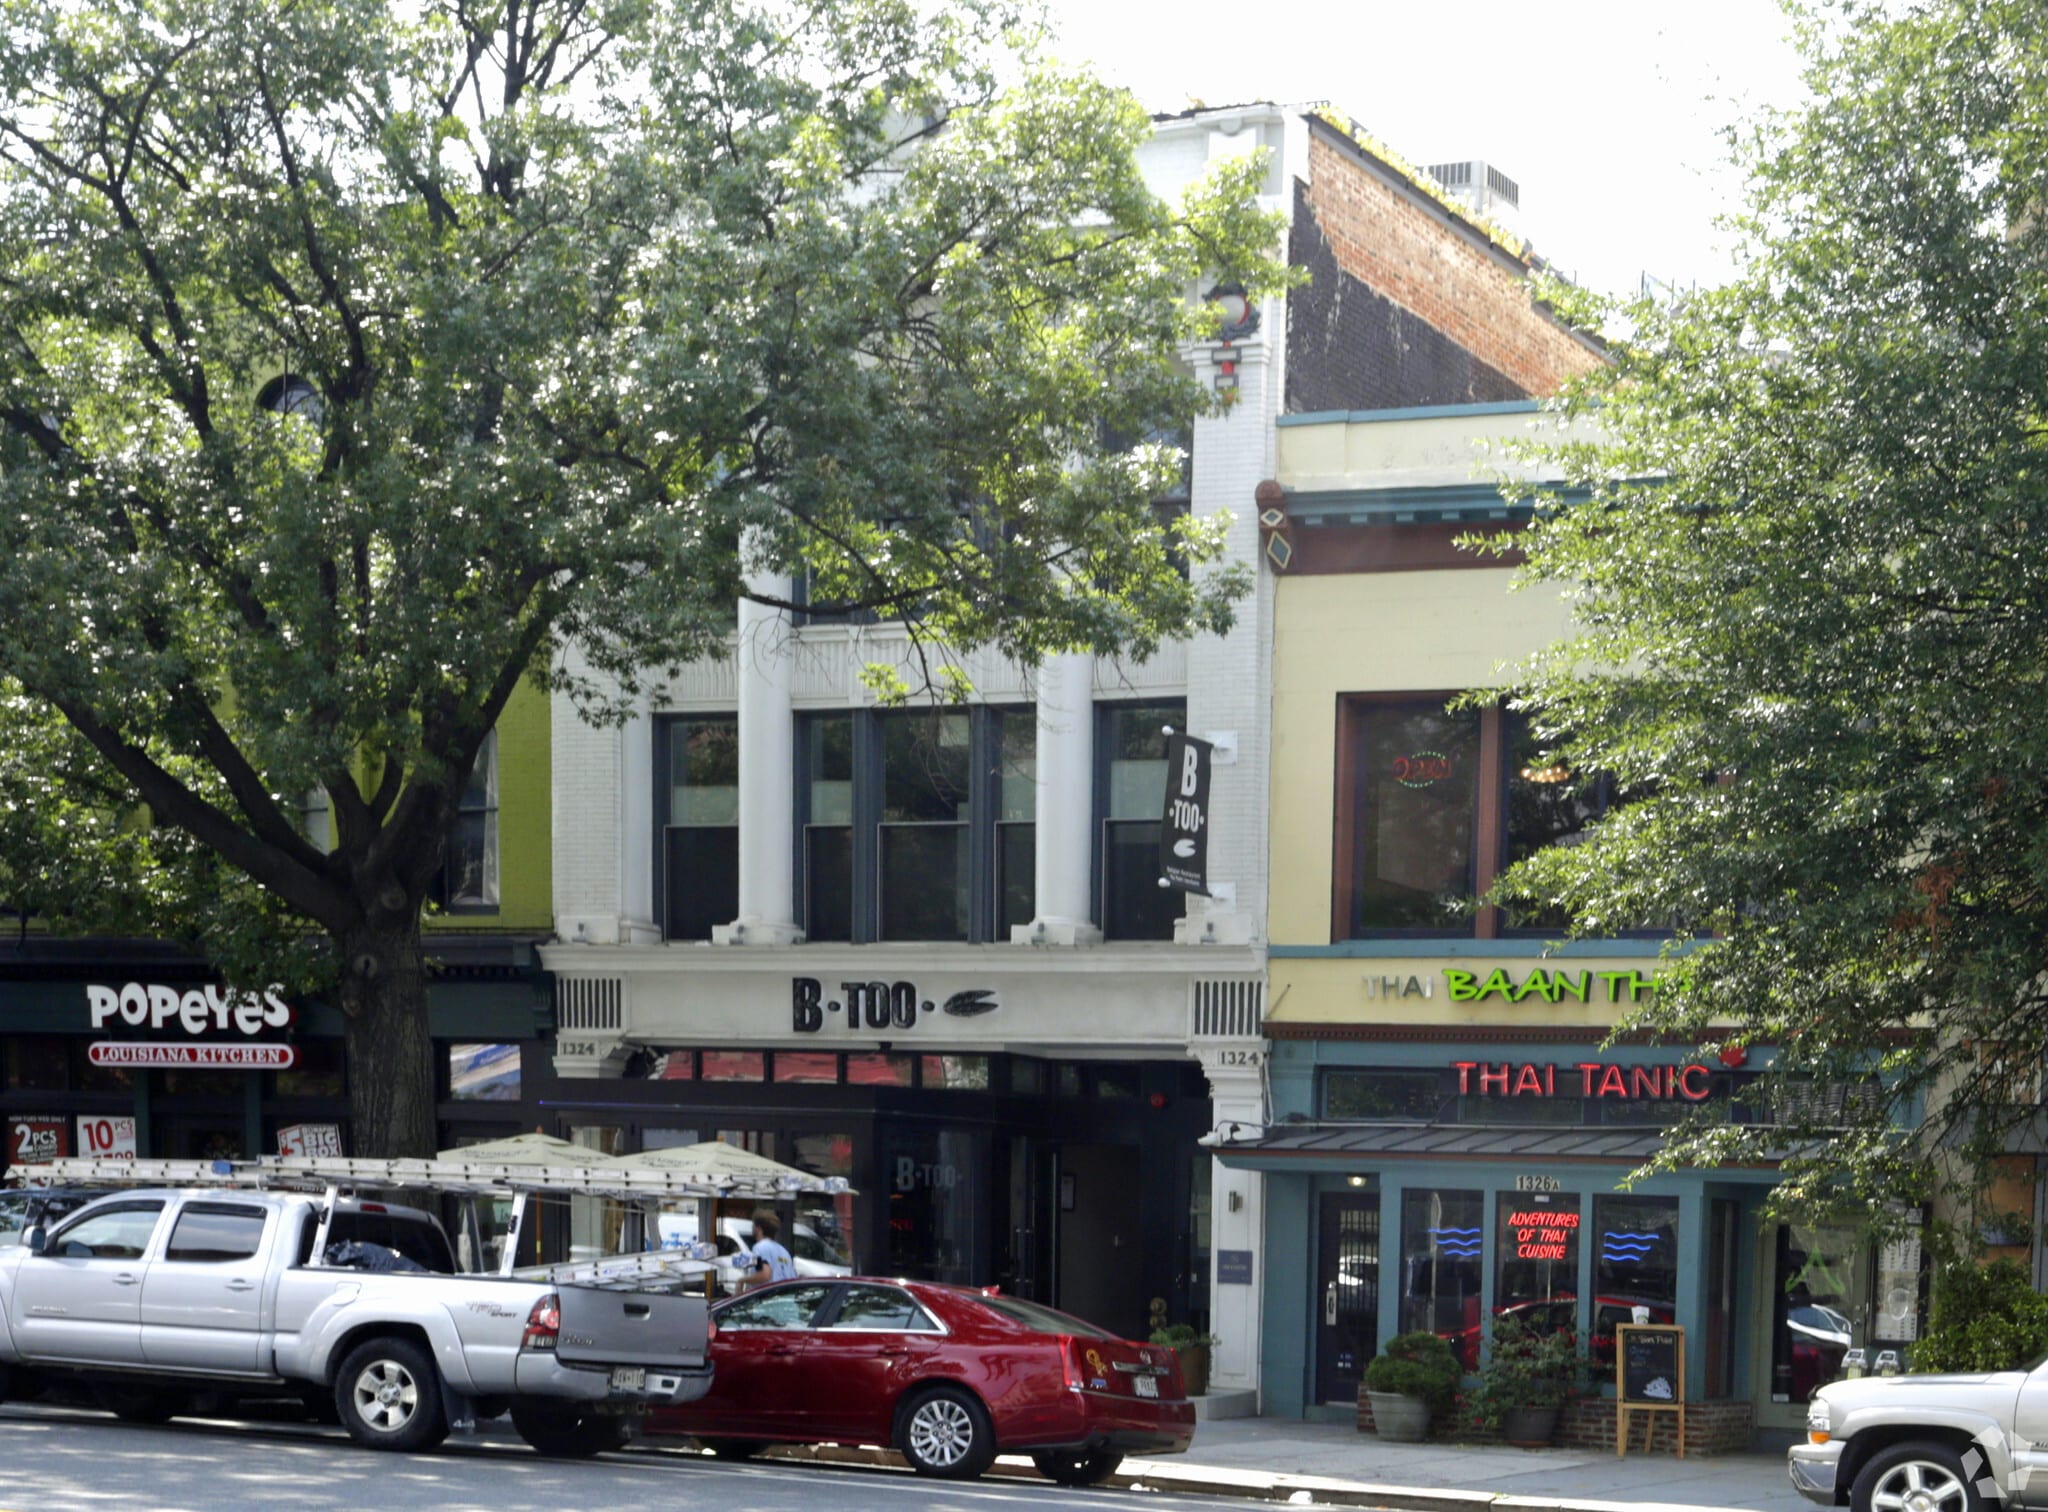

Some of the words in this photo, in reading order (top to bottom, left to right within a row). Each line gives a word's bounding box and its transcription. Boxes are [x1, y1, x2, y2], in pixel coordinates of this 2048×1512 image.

[1181, 744, 1198, 797] B
[1361, 975, 1434, 999] THAI
[1443, 968, 1592, 1002] BAAN
[99, 1046, 191, 1063] LOUISIANA
[196, 1047, 281, 1064] KITCHEN
[563, 1042, 595, 1056] 1324
[1221, 1051, 1259, 1065] 1324
[1455, 1061, 1555, 1097] THAI
[1577, 1062, 1710, 1100] TANIC
[15, 1123, 34, 1153] 2
[32, 1130, 57, 1145] PCS
[83, 1119, 114, 1152] 10
[303, 1131, 338, 1147] BIG
[305, 1145, 340, 1158] BOX
[1508, 1211, 1580, 1228] ADVENTURES
[1517, 1228, 1537, 1242] OF
[1540, 1228, 1567, 1243] THAI
[1518, 1244, 1567, 1259] CUISINE
